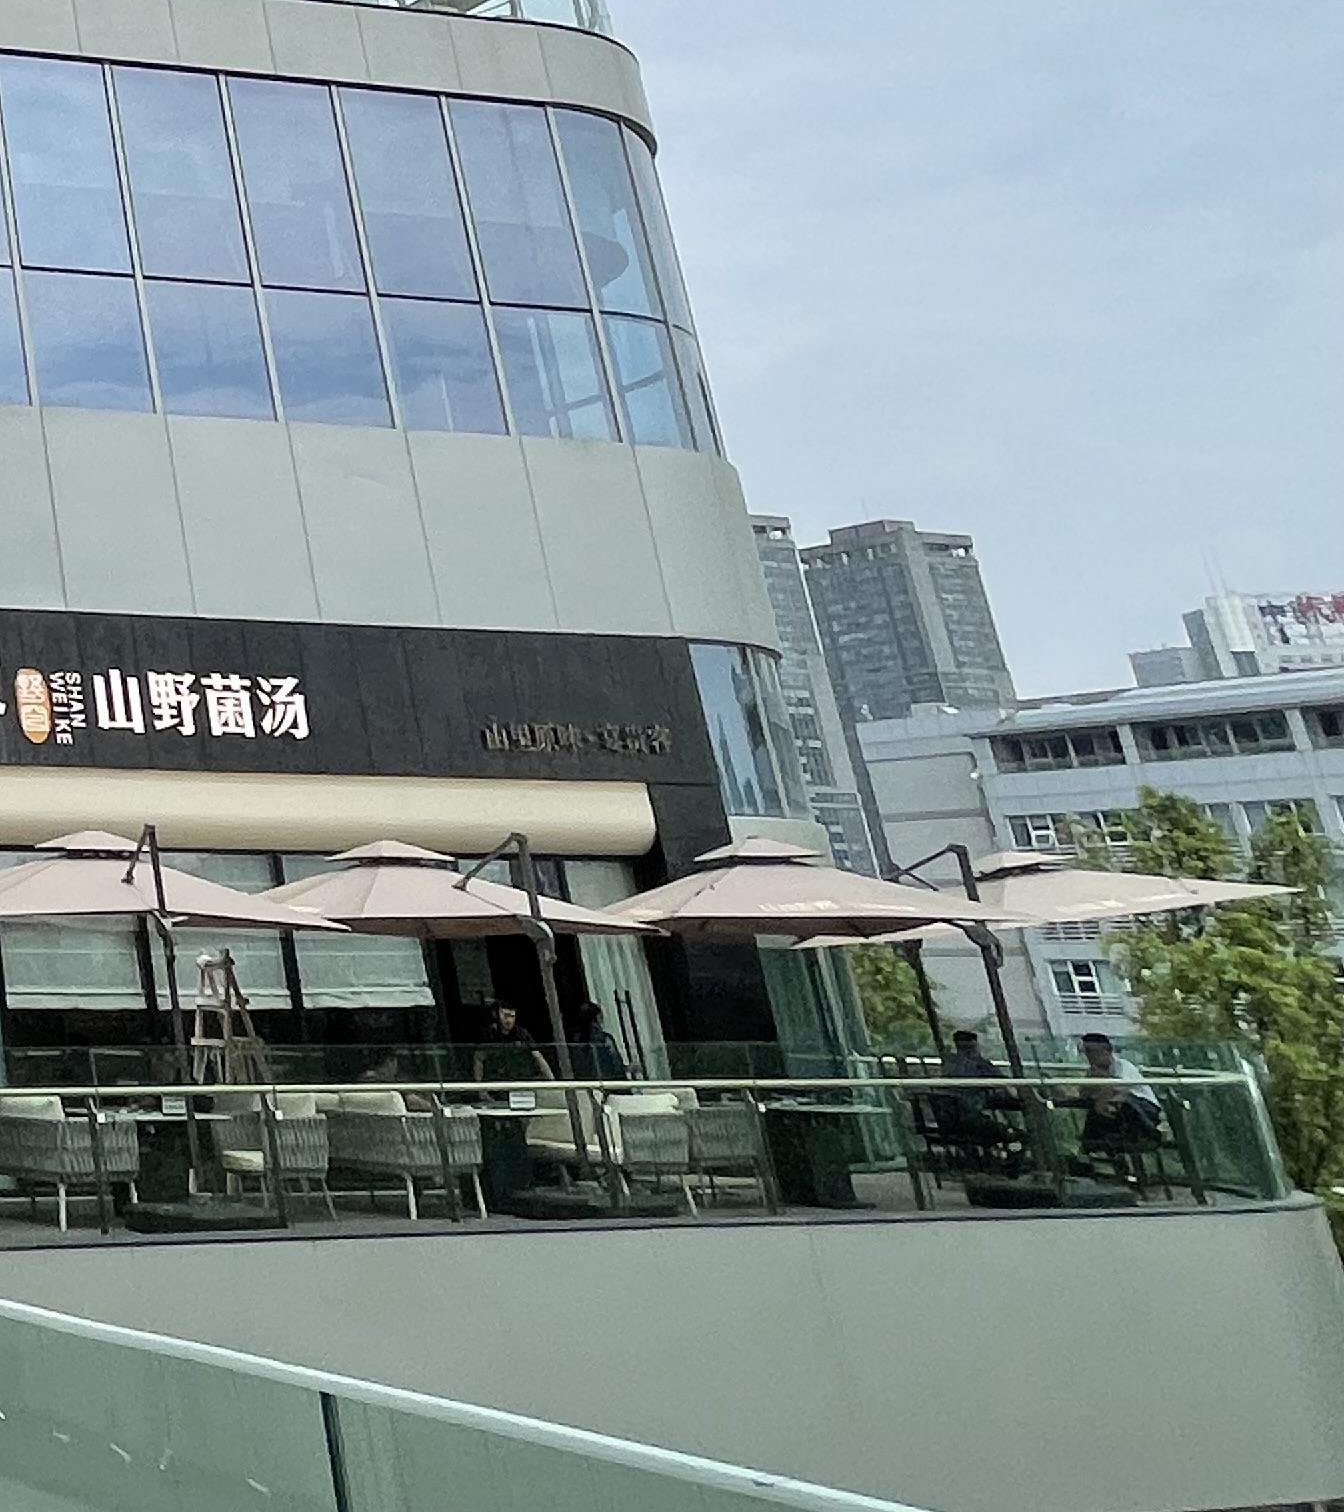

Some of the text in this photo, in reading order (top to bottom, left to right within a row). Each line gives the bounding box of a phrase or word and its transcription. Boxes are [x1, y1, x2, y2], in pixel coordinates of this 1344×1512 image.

[64, 672, 87, 728] SHAN
[92, 668, 310, 740] 山野菌汤
